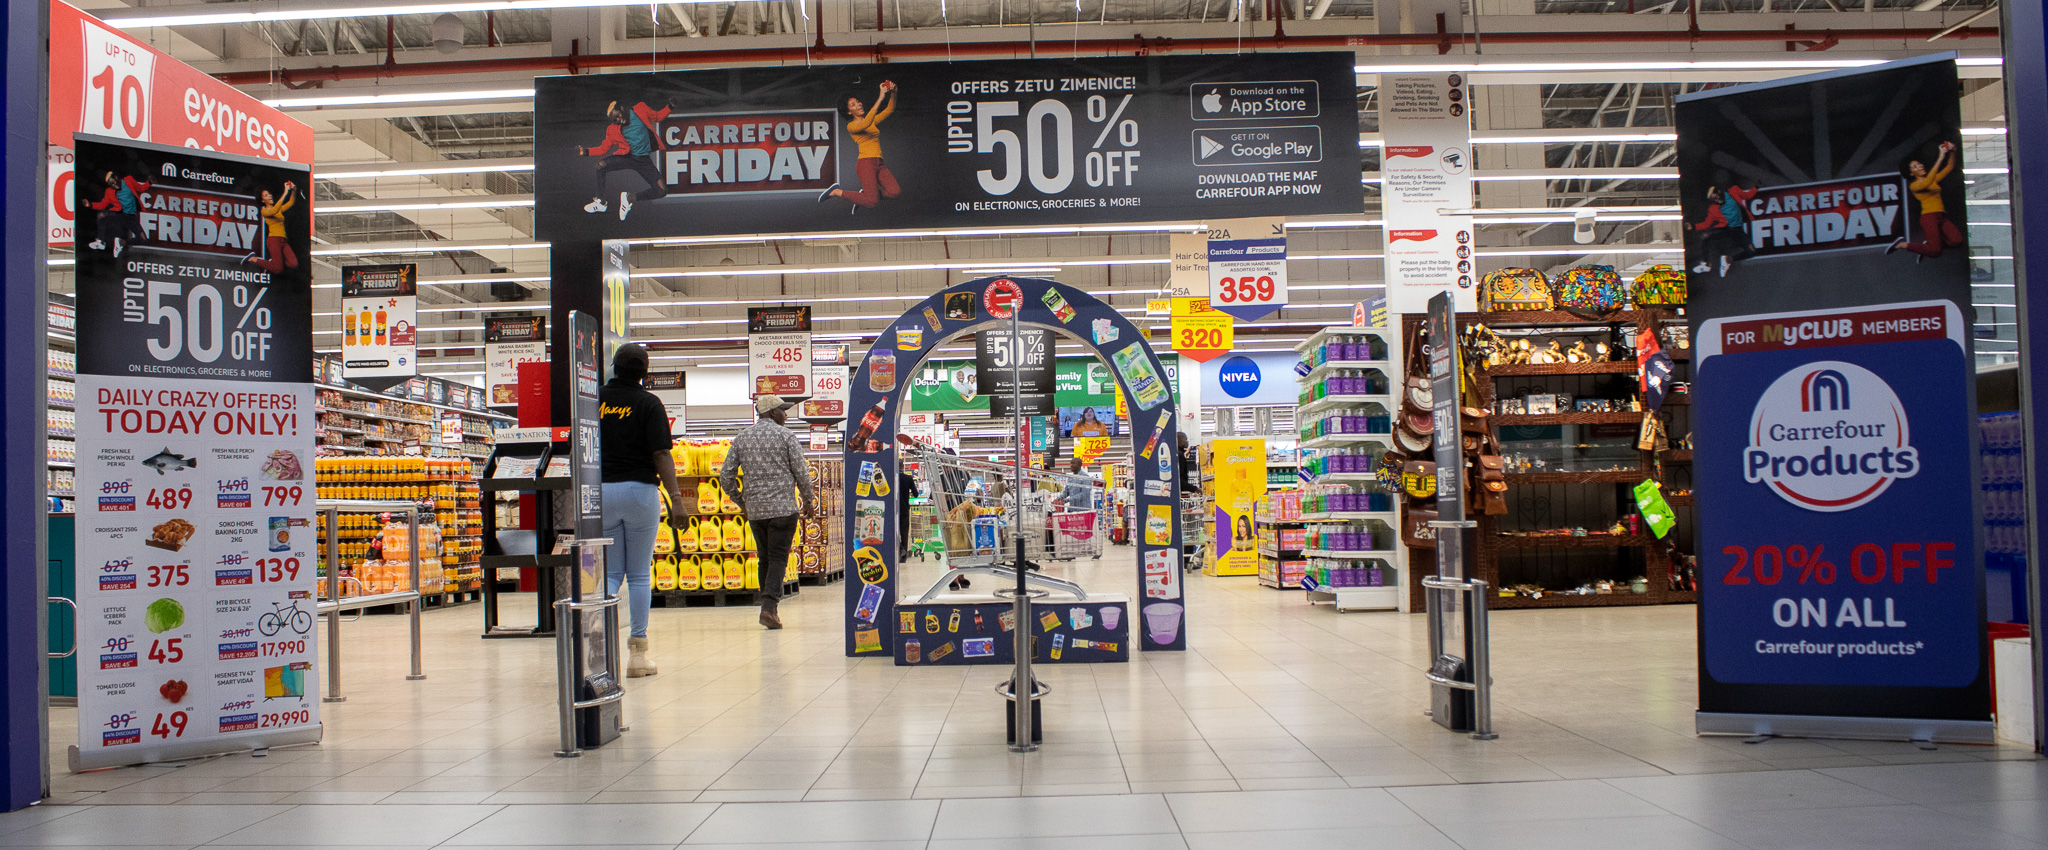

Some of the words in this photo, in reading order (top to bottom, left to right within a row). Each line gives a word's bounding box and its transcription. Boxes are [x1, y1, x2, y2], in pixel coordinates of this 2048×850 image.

[105, 42, 121, 57] UP
[123, 47, 136, 67] TO
[951, 80, 1009, 95] OFFERS
[1015, 78, 1055, 92] ZETU
[1060, 76, 1136, 91] ZIMENICE!
[1230, 87, 1274, 97] Download
[1276, 88, 1286, 96] on
[1290, 86, 1305, 95] the
[92, 65, 145, 140] 10
[1230, 99, 1263, 115] App
[1265, 97, 1306, 112] Store
[184, 87, 290, 162] express
[665, 120, 829, 146] CARREFOUR
[947, 100, 974, 154] UPTO
[1087, 94, 1139, 150] %
[976, 98, 1075, 196] 50
[1231, 142, 1281, 159] Google
[1284, 141, 1313, 159] Play
[665, 145, 829, 185] FRIDAY
[1085, 151, 1141, 188] OFF
[182, 168, 235, 185] Carrefour
[1198, 173, 1266, 186] DOWNLOAD
[1267, 172, 1291, 183] THE
[1293, 171, 1318, 183] MAF
[1195, 186, 1266, 199] CARREFOUR
[1267, 185, 1291, 197] APP
[1292, 184, 1322, 196] NOW
[1751, 183, 1898, 216] CARREFOUR
[140, 192, 259, 221] CARREFOUR
[955, 201, 970, 211] ON
[1042, 198, 1095, 210] GROCERIES
[1099, 198, 1107, 208] &
[1110, 197, 1141, 207] MORE!
[139, 212, 258, 250] FRIDAY
[1208, 229, 1231, 240] 22A
[1751, 205, 1899, 249] FRIDAY
[127, 261, 173, 276] OFFERS
[178, 266, 210, 278] ZETU
[214, 269, 271, 284] ZIMENICE!
[1176, 264, 1192, 272] Hair
[363, 279, 397, 289] FRIDAY
[1172, 288, 1191, 296] 25A
[1219, 275, 1275, 303] 359
[123, 277, 145, 323] UPTO
[985, 283, 997, 308] INFLATION
[233, 285, 272, 330] %
[146, 280, 223, 363] 50
[1727, 331, 1756, 346] FOR
[1763, 319, 1853, 347] MyCLUB
[1862, 317, 1942, 336] MEMBERS
[231, 331, 273, 361] OFF
[1181, 329, 1222, 348] 320
[772, 348, 803, 363] 485
[1027, 353, 1044, 365] OFF
[128, 364, 141, 372] ON
[198, 367, 238, 377] GROCERIES
[248, 370, 272, 378] MORE!
[1222, 372, 1258, 382] NIVEA
[817, 378, 842, 390] 469
[1062, 383, 1082, 391] Virus
[1133, 377, 1156, 391] PANDA
[98, 388, 154, 406] DAILY
[158, 390, 219, 408] CRAZY
[223, 392, 297, 410] OFFERS!
[98, 408, 207, 434] TODAY
[213, 411, 297, 436] ONLY!
[1769, 420, 1886, 443] Carrefour
[496, 432, 516, 440] DAILY
[522, 431, 550, 439] NATION
[1088, 439, 1108, 450] 725
[1747, 446, 1915, 479] Products
[146, 488, 193, 510] 489
[260, 486, 303, 507] 799
[864, 508, 884, 517] SOKO
[1146, 522, 1166, 531] Sunlight
[256, 557, 300, 583] 139
[1721, 544, 1836, 587] 20%
[1850, 541, 1956, 585] OFF
[147, 565, 190, 587] 375
[1773, 597, 1828, 628] ON
[1835, 597, 1907, 628] ALL
[148, 638, 184, 664] 45
[260, 640, 306, 658] 17,990
[1755, 638, 1834, 655] Carrefour
[215, 671, 238, 679] HISENSE
[151, 711, 189, 739] 49
[261, 710, 310, 728] 29,990
